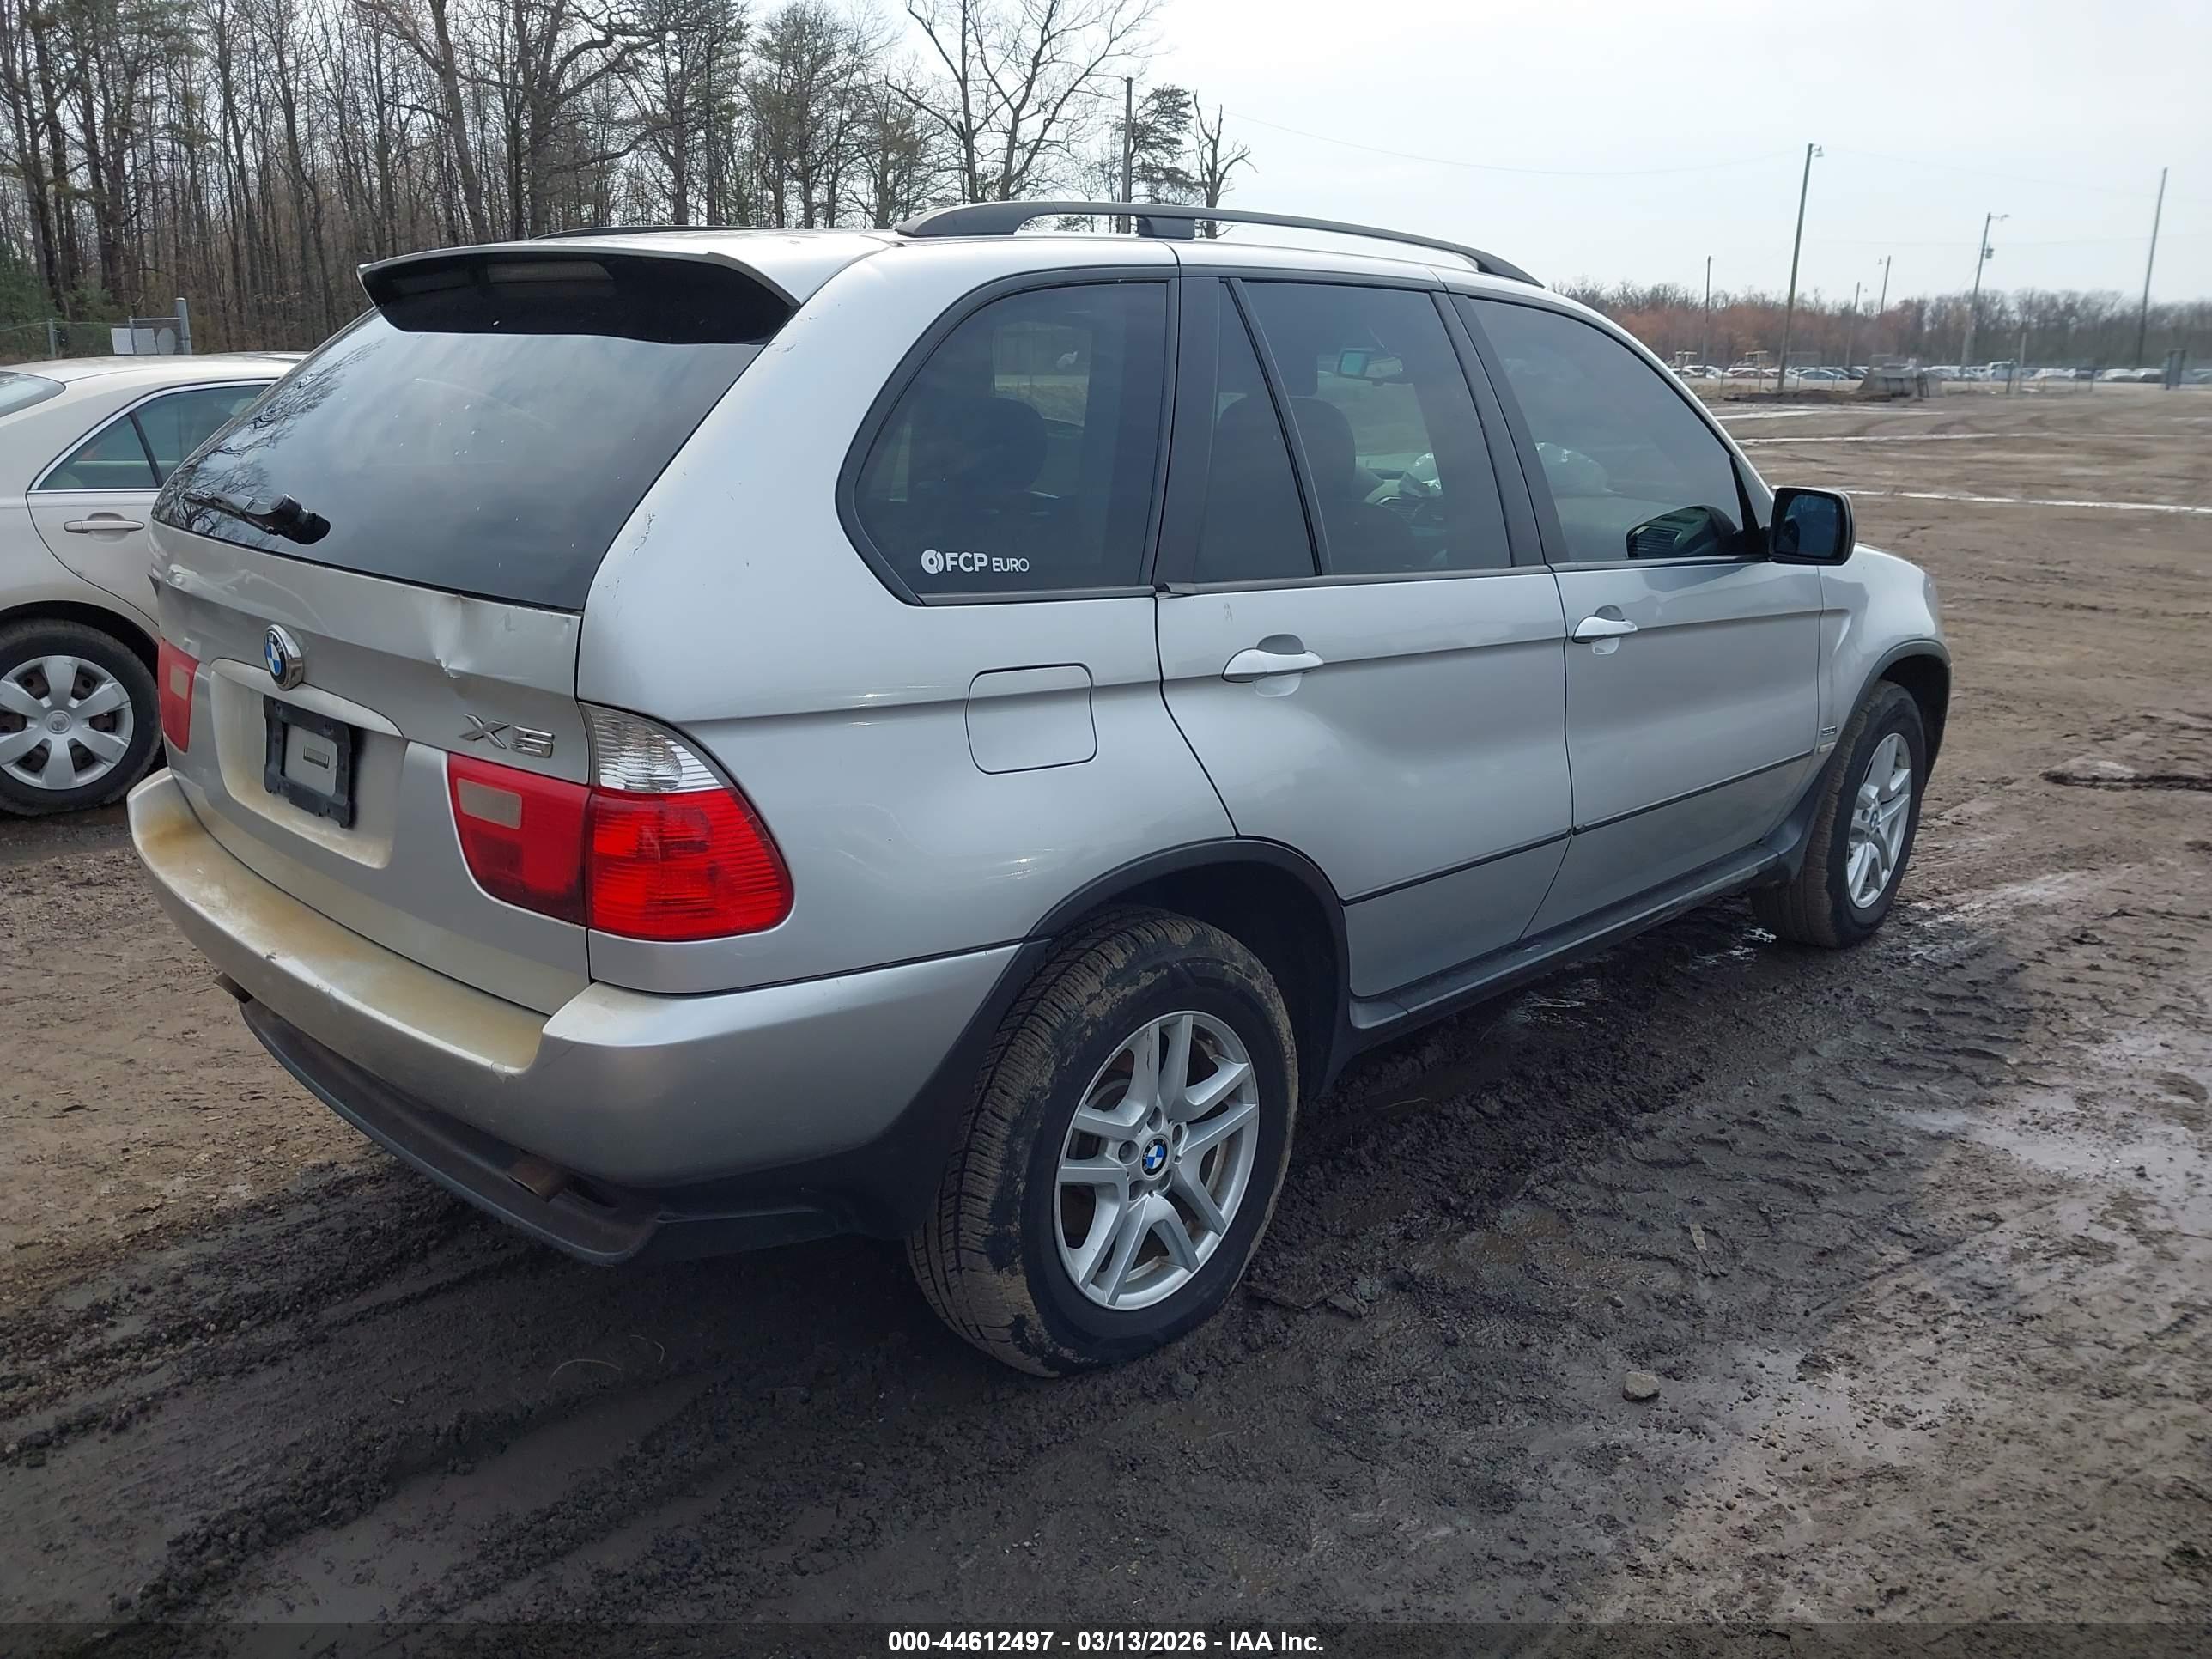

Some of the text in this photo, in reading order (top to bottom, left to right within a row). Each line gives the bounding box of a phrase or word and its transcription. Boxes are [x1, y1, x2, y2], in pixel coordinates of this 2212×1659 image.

[945, 552, 1030, 573] FCP EURO
[459, 714, 555, 759] X5
